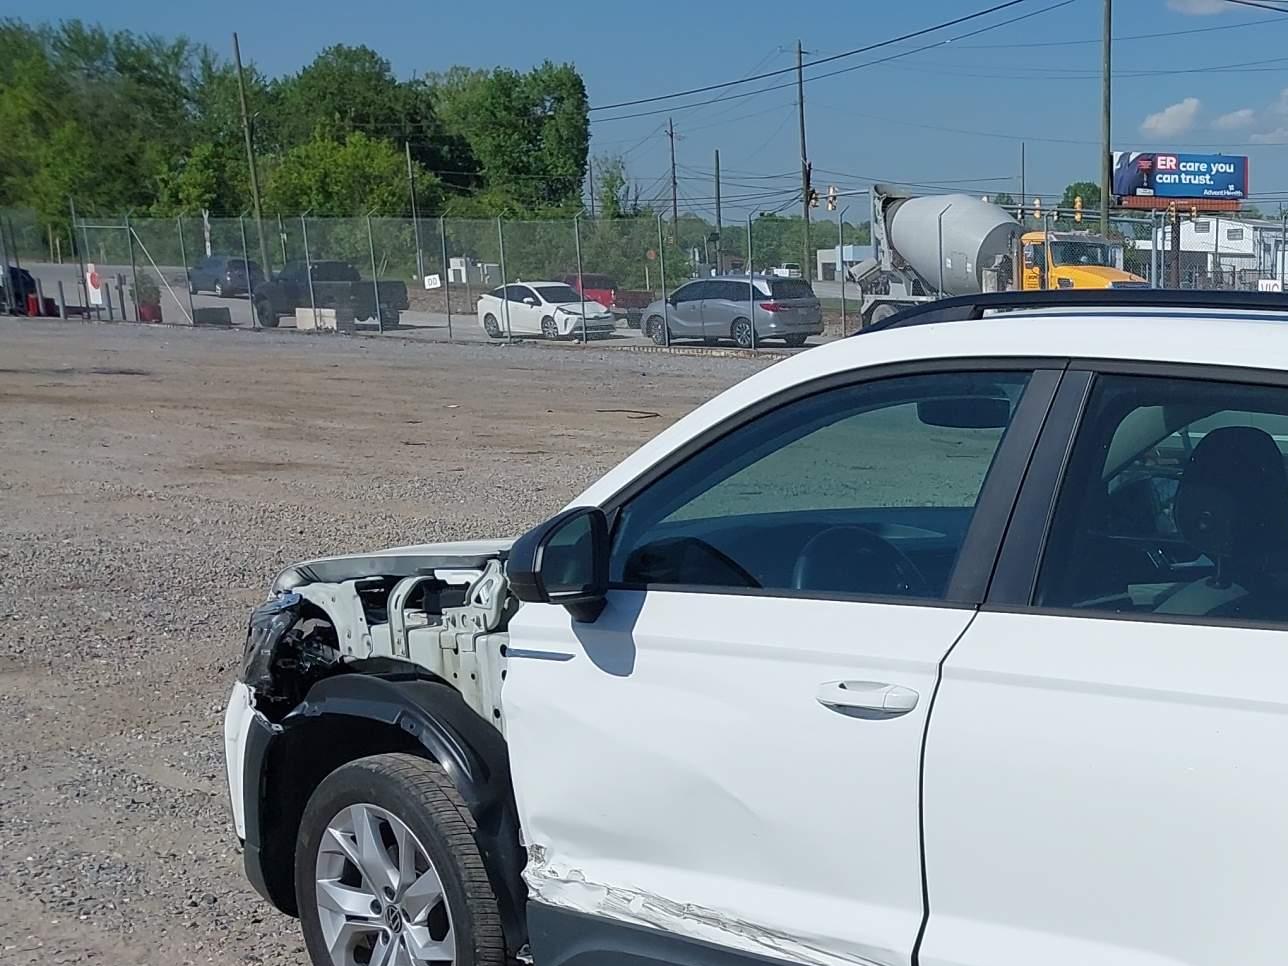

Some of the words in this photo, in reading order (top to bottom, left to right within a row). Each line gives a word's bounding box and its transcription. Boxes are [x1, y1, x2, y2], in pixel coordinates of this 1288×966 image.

[1157, 156, 1176, 169] ER
[1180, 162, 1207, 172] care
[1211, 163, 1234, 174] you
[1156, 174, 1179, 184] can
[1181, 174, 1214, 185] trust.
